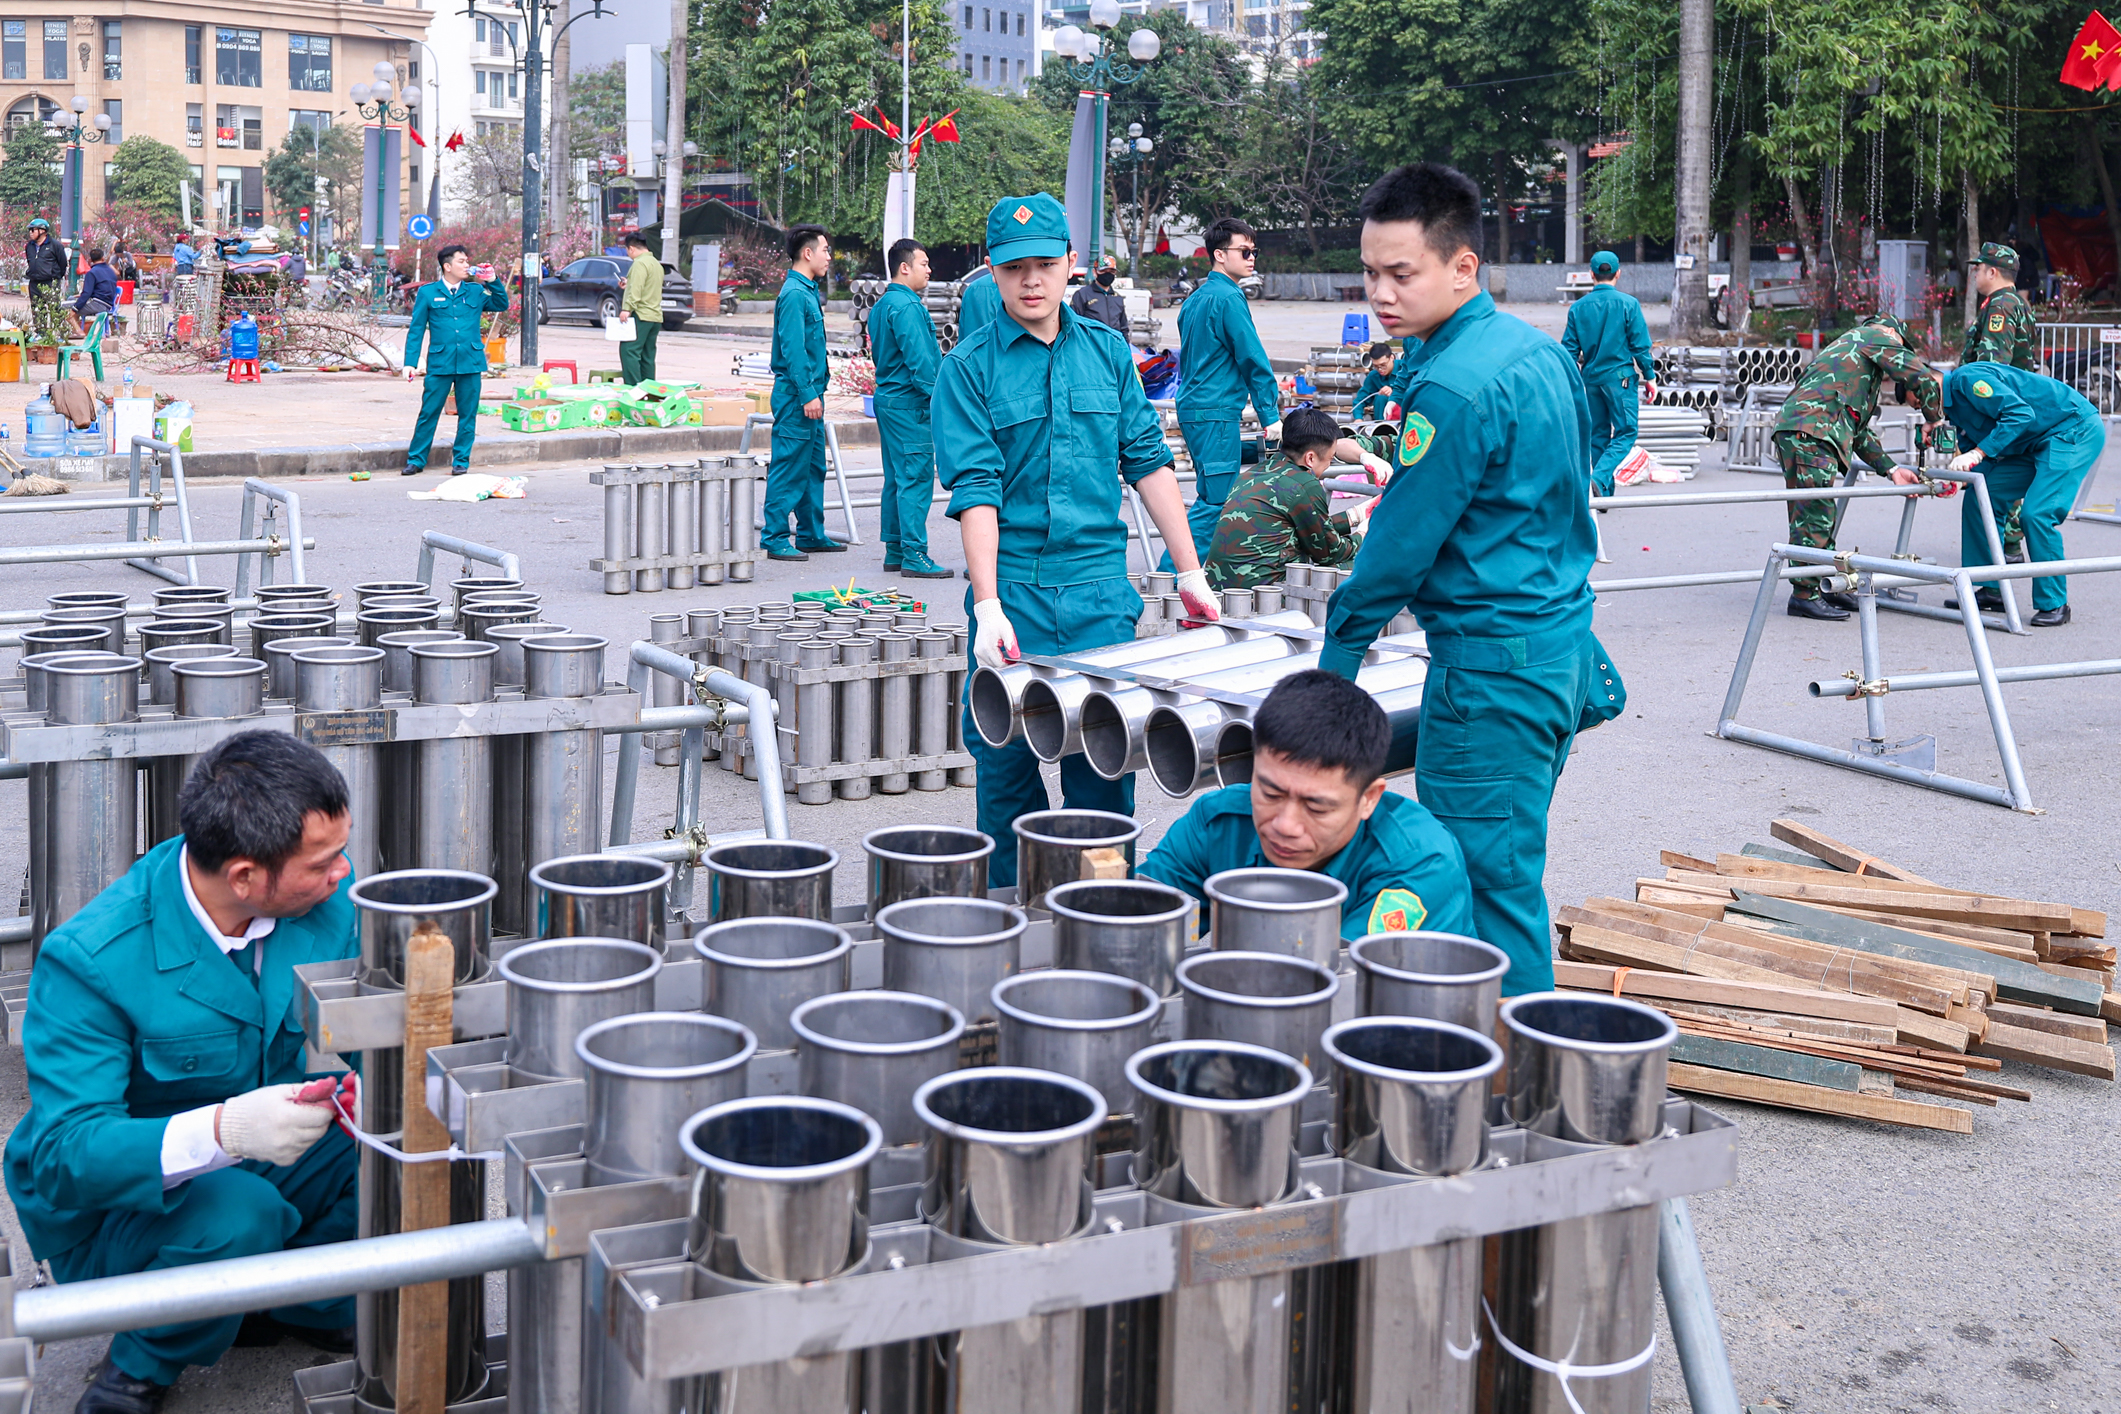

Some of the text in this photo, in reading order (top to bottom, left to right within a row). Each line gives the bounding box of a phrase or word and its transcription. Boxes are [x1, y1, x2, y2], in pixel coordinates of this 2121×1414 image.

[187, 131, 202, 140] Nail
[187, 139, 203, 147] Hair
[217, 137, 239, 146] Salon
